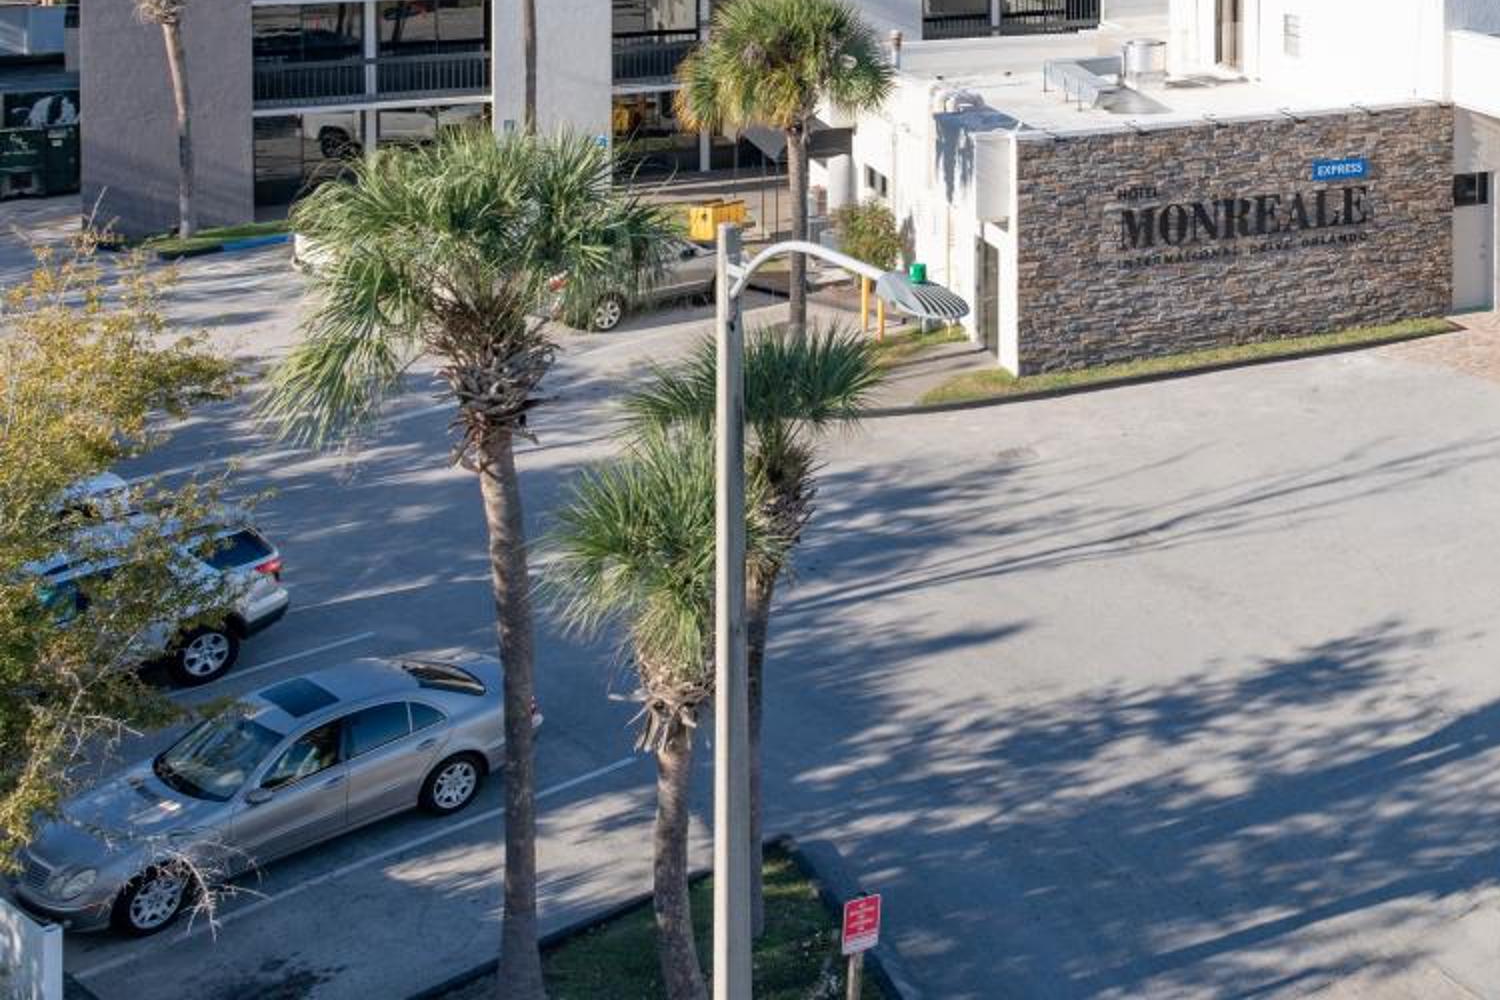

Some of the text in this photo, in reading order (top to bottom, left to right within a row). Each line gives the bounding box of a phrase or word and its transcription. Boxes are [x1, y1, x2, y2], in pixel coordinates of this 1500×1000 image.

[1317, 162, 1363, 177] EXPRESS
[1117, 186, 1157, 200] HOTEL
[1119, 186, 1367, 250] MONREALE
[1301, 232, 1369, 247] ORLANDO
